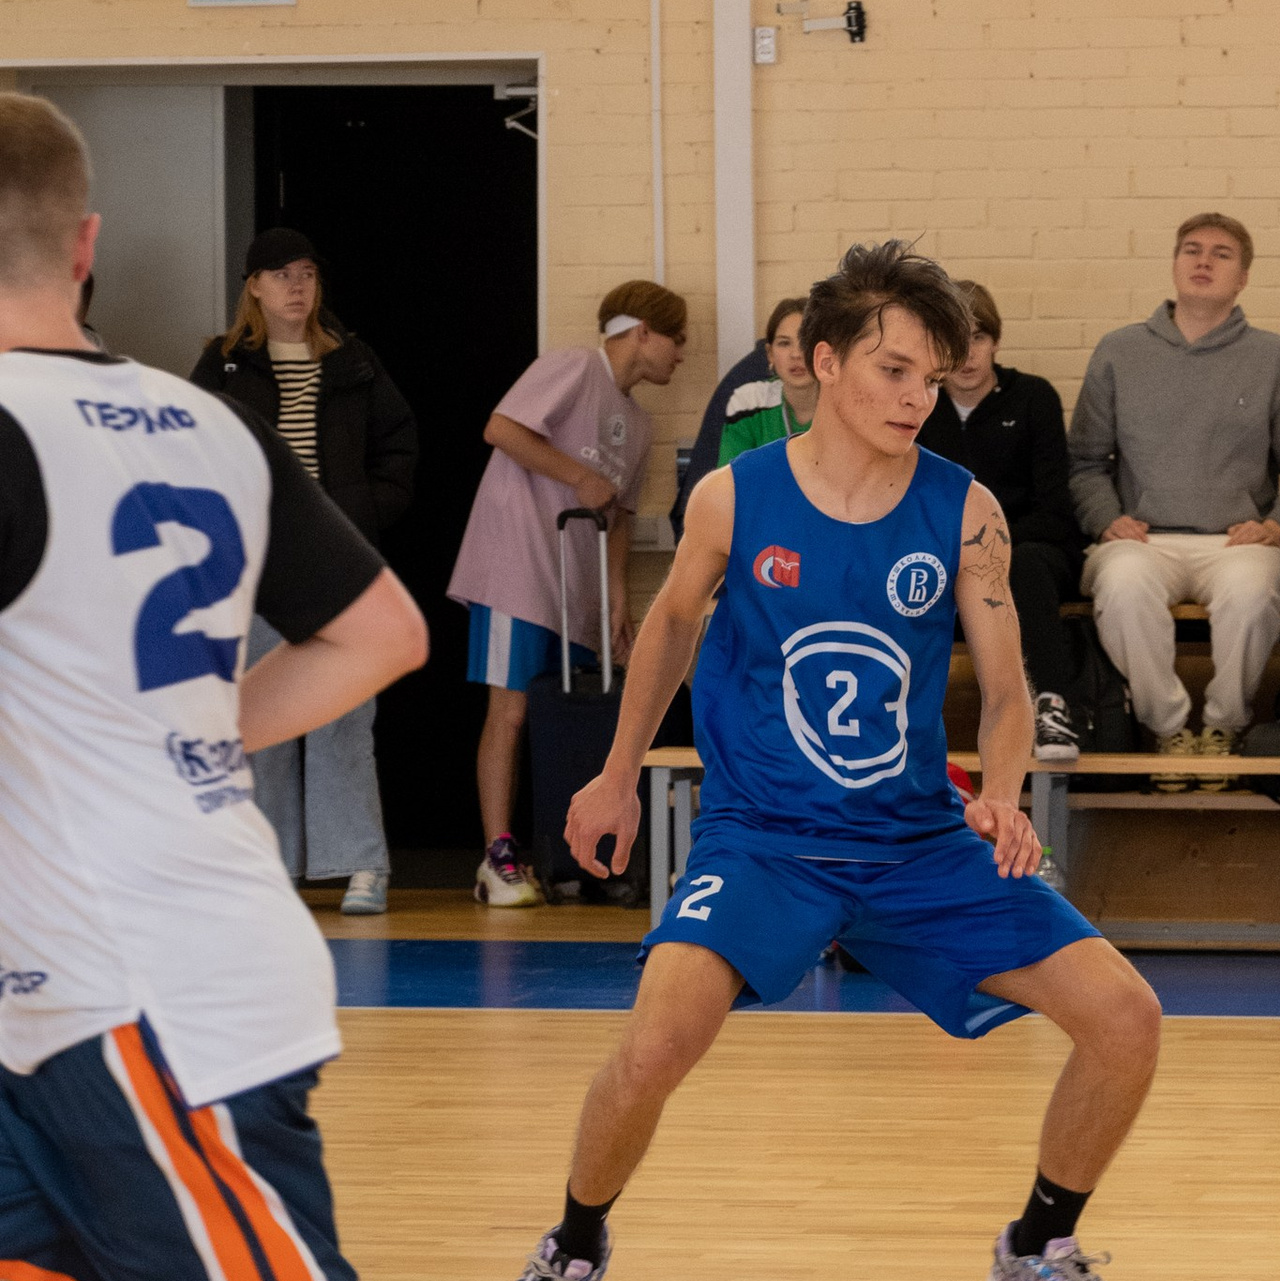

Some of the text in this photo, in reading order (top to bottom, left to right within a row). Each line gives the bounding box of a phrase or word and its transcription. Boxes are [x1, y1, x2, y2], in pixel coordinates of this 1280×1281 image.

[110, 481, 248, 692] 2
[826, 670, 860, 737] 2
[676, 874, 724, 921] 2
